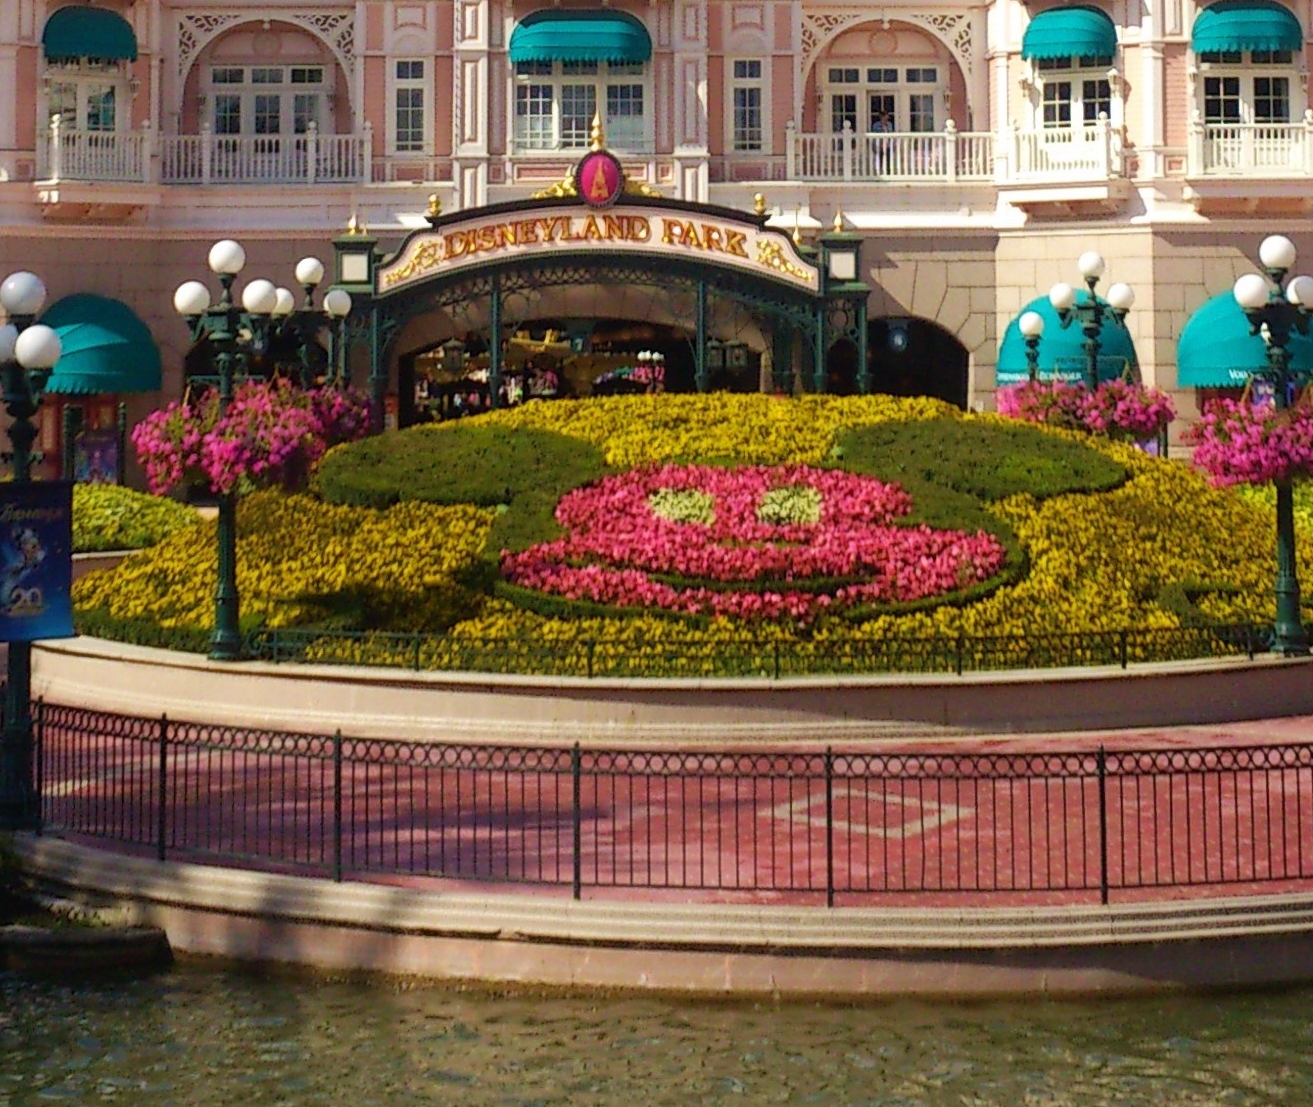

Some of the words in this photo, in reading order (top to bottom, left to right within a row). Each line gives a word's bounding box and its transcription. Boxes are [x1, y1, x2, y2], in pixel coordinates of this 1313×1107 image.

[443, 215, 651, 260] DISNEYLAND
[660, 218, 750, 259] PARK
[10, 586, 43, 606] 20
